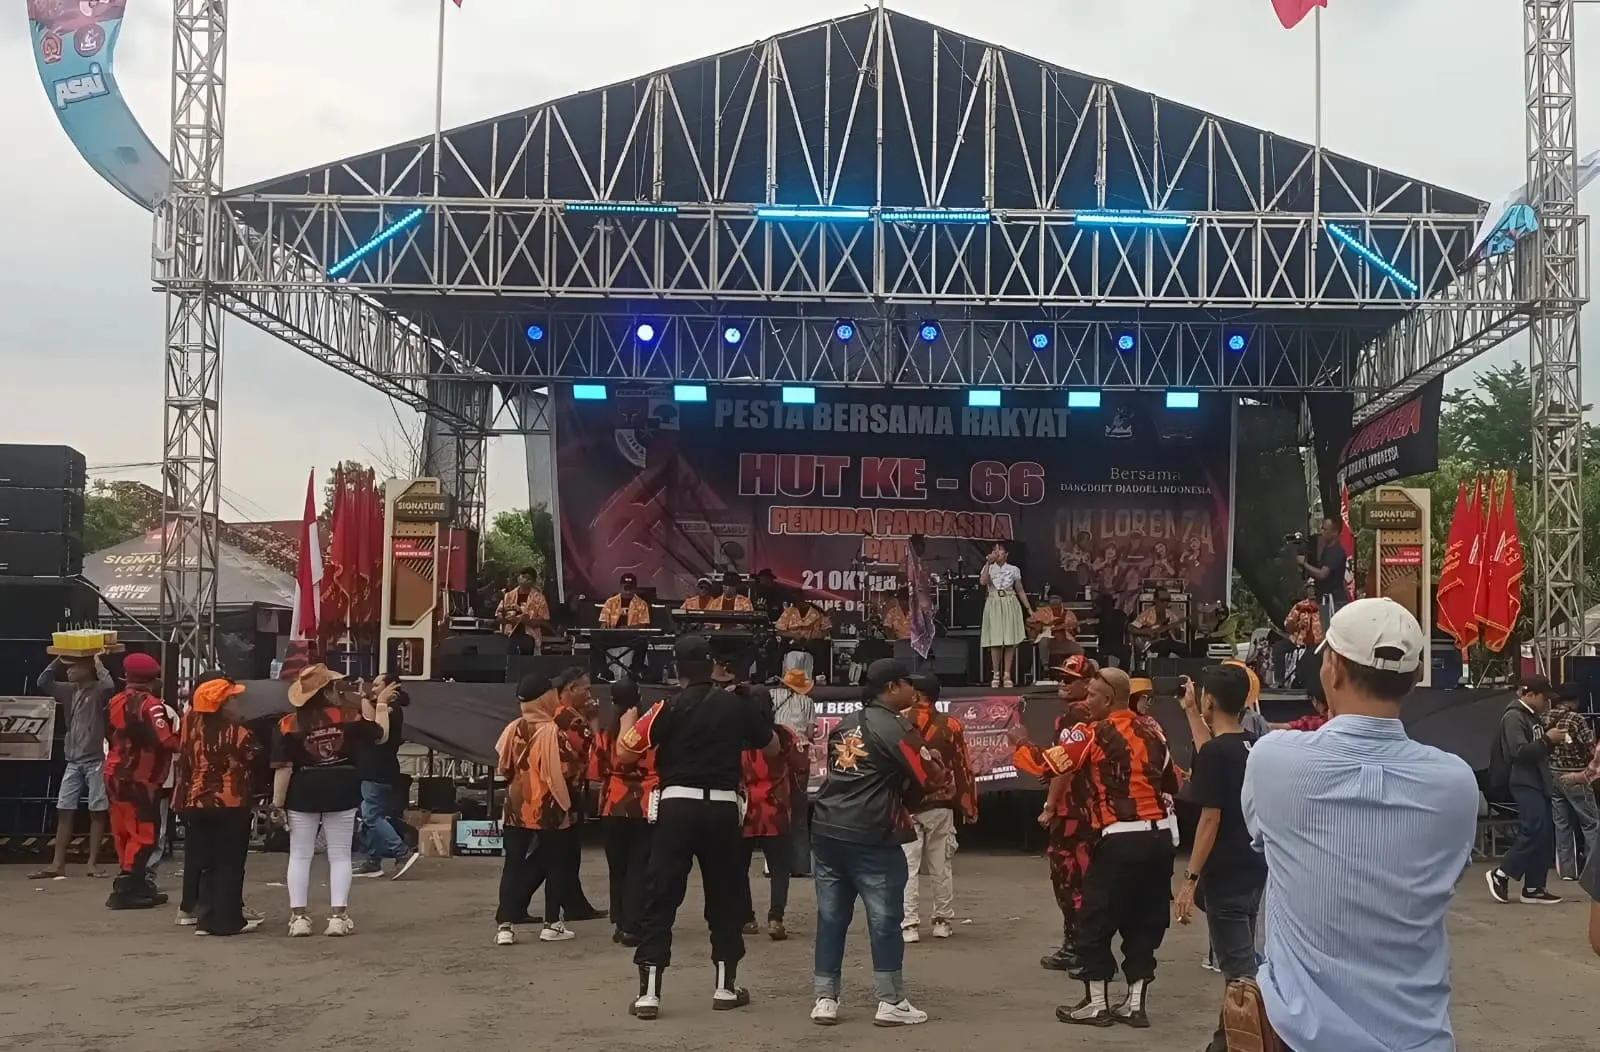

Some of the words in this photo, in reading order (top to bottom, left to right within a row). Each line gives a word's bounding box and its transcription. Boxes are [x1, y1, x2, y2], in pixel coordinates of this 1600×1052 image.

[714, 398, 805, 430] PESTA
[812, 402, 953, 435] BERSAMA
[961, 405, 1071, 438] RAKYAT
[739, 453, 850, 497] HUT
[861, 456, 927, 500] KE
[969, 460, 1045, 505] 66
[1110, 467, 1181, 480] Bersama
[1160, 486, 1212, 495] INDONESIA
[397, 502, 446, 511] SIGNATURE
[1370, 510, 1417, 518] SIGNATURE
[768, 505, 875, 535] PEMUDA
[874, 508, 1014, 541] PANCASILA
[1101, 508, 1215, 554] LORENZA
[801, 570, 824, 590] 21
